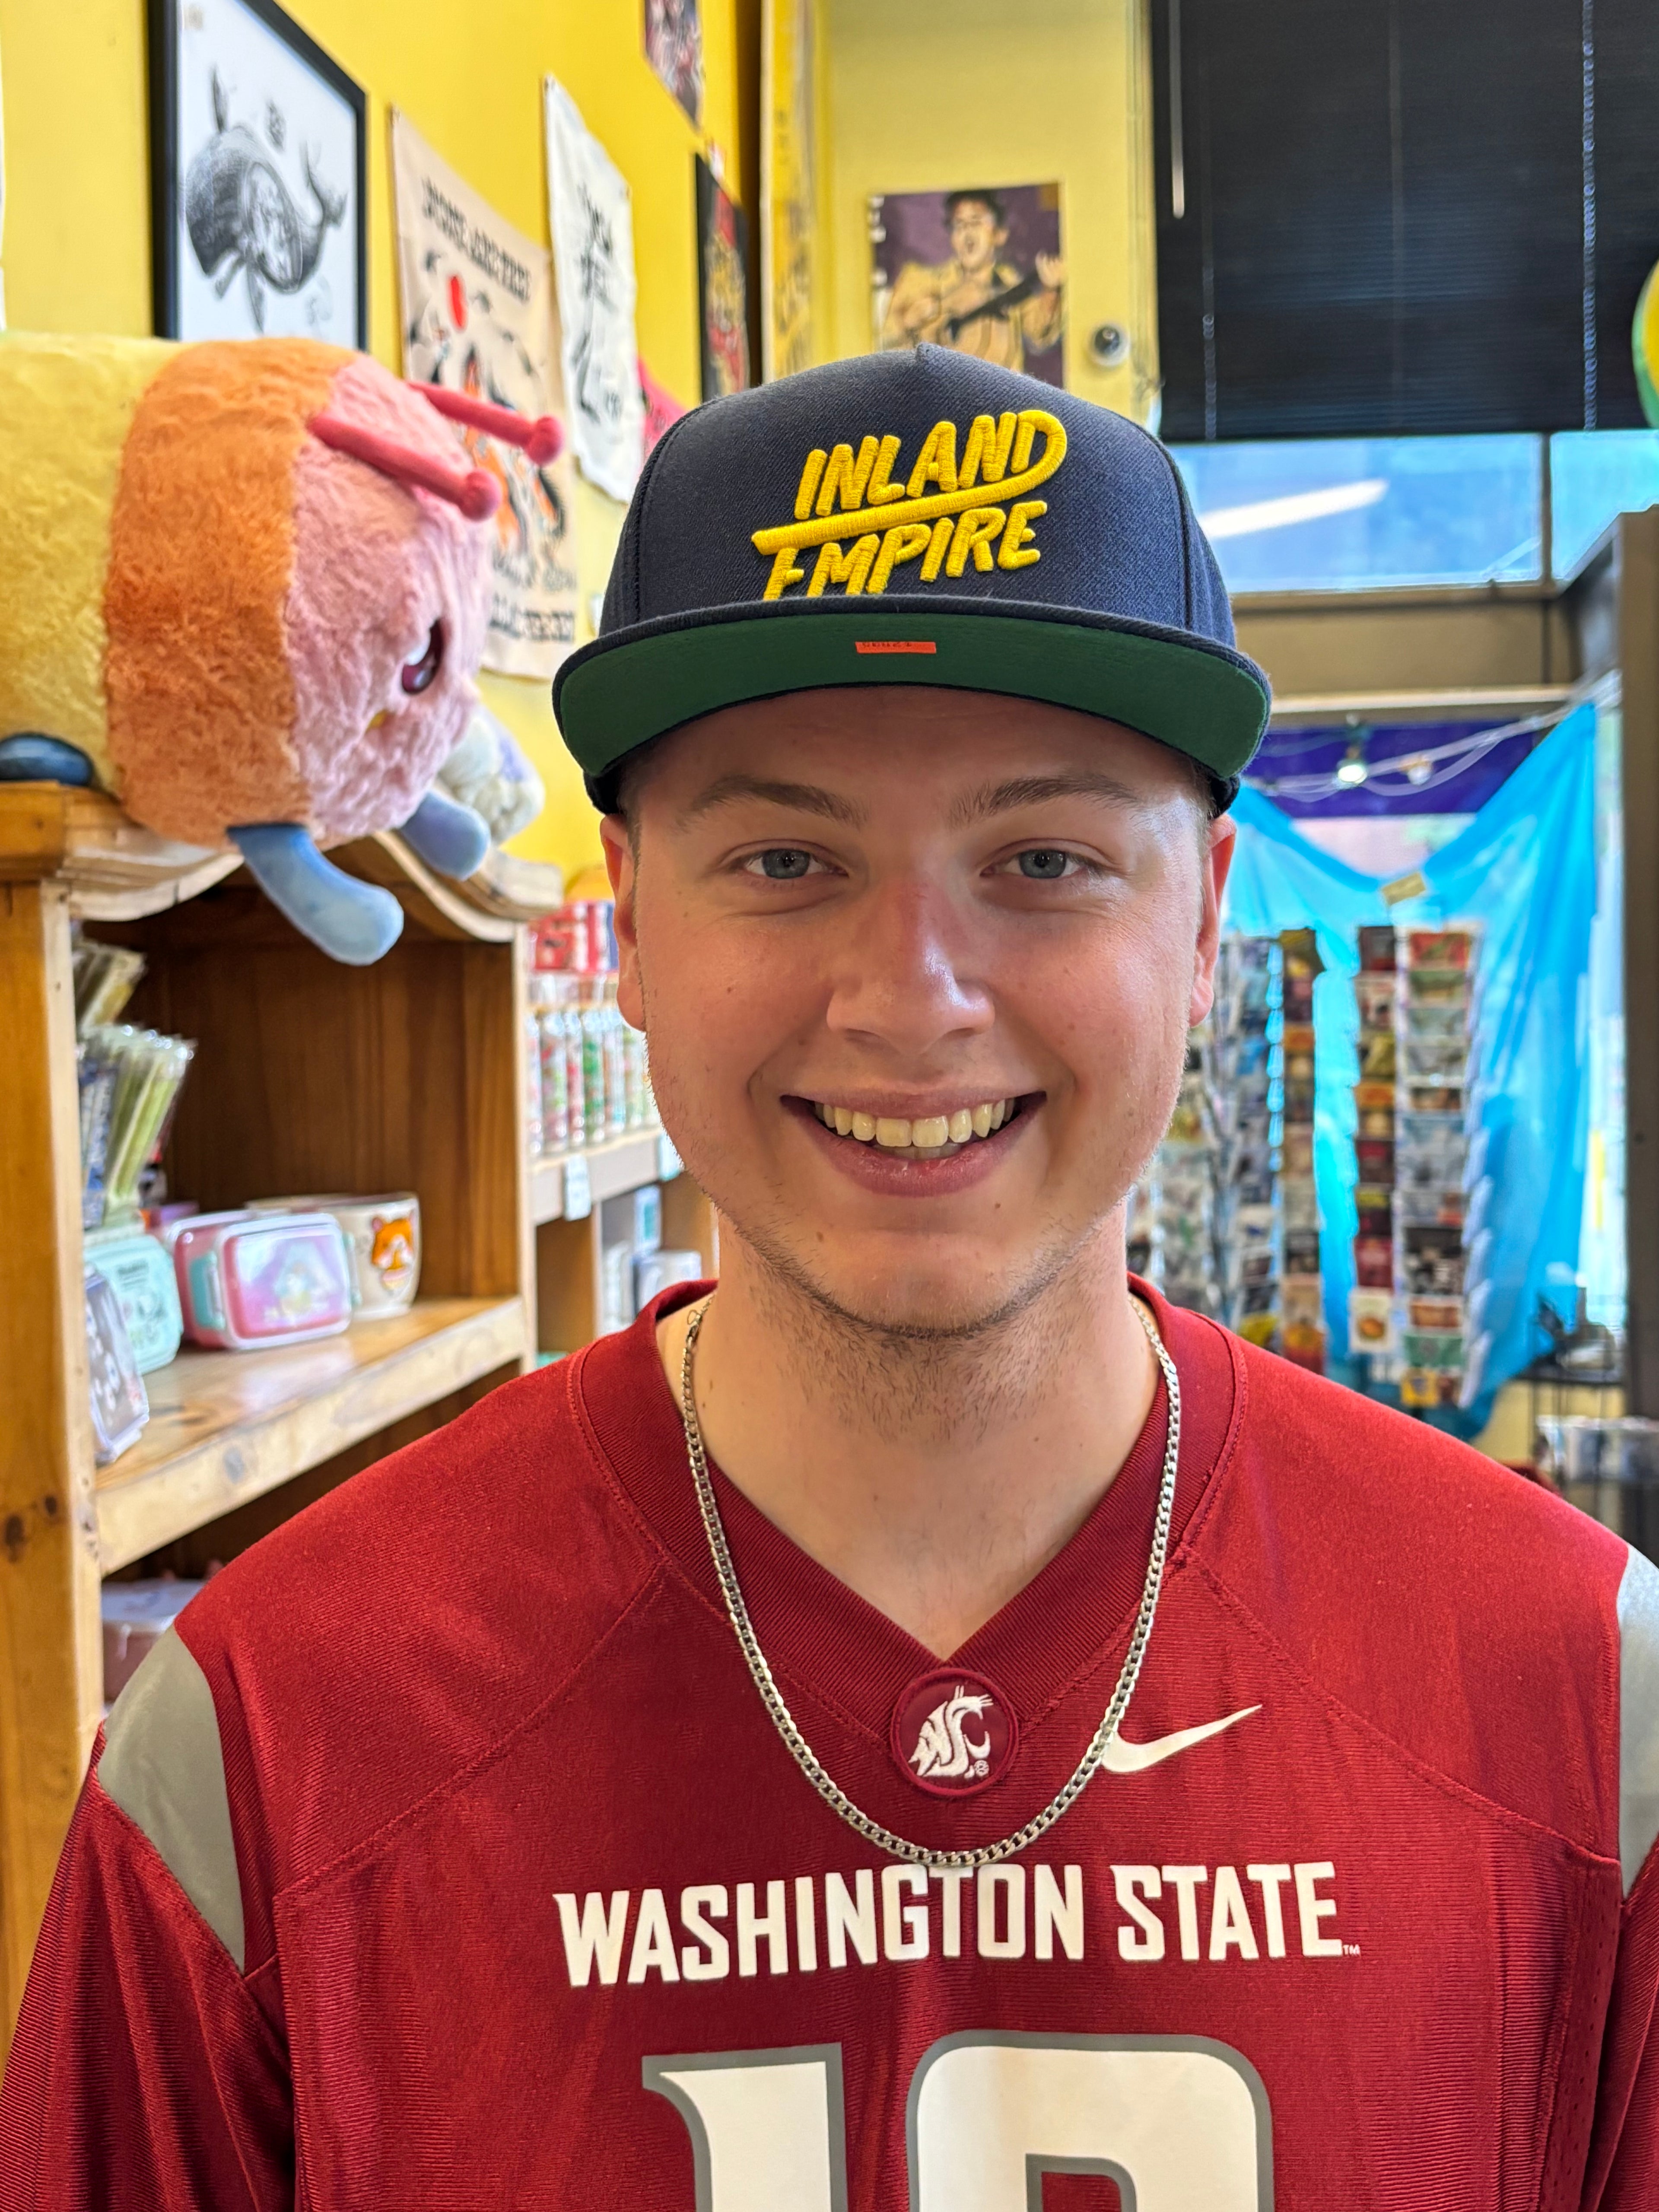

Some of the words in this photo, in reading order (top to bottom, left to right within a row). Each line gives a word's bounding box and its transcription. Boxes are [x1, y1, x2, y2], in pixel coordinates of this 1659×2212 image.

[794, 410, 1068, 520] INLAND
[763, 500, 1048, 601] EMPIRE
[552, 1863, 1084, 1987] WASHINGTON
[1109, 1861, 1343, 1961] STATE
